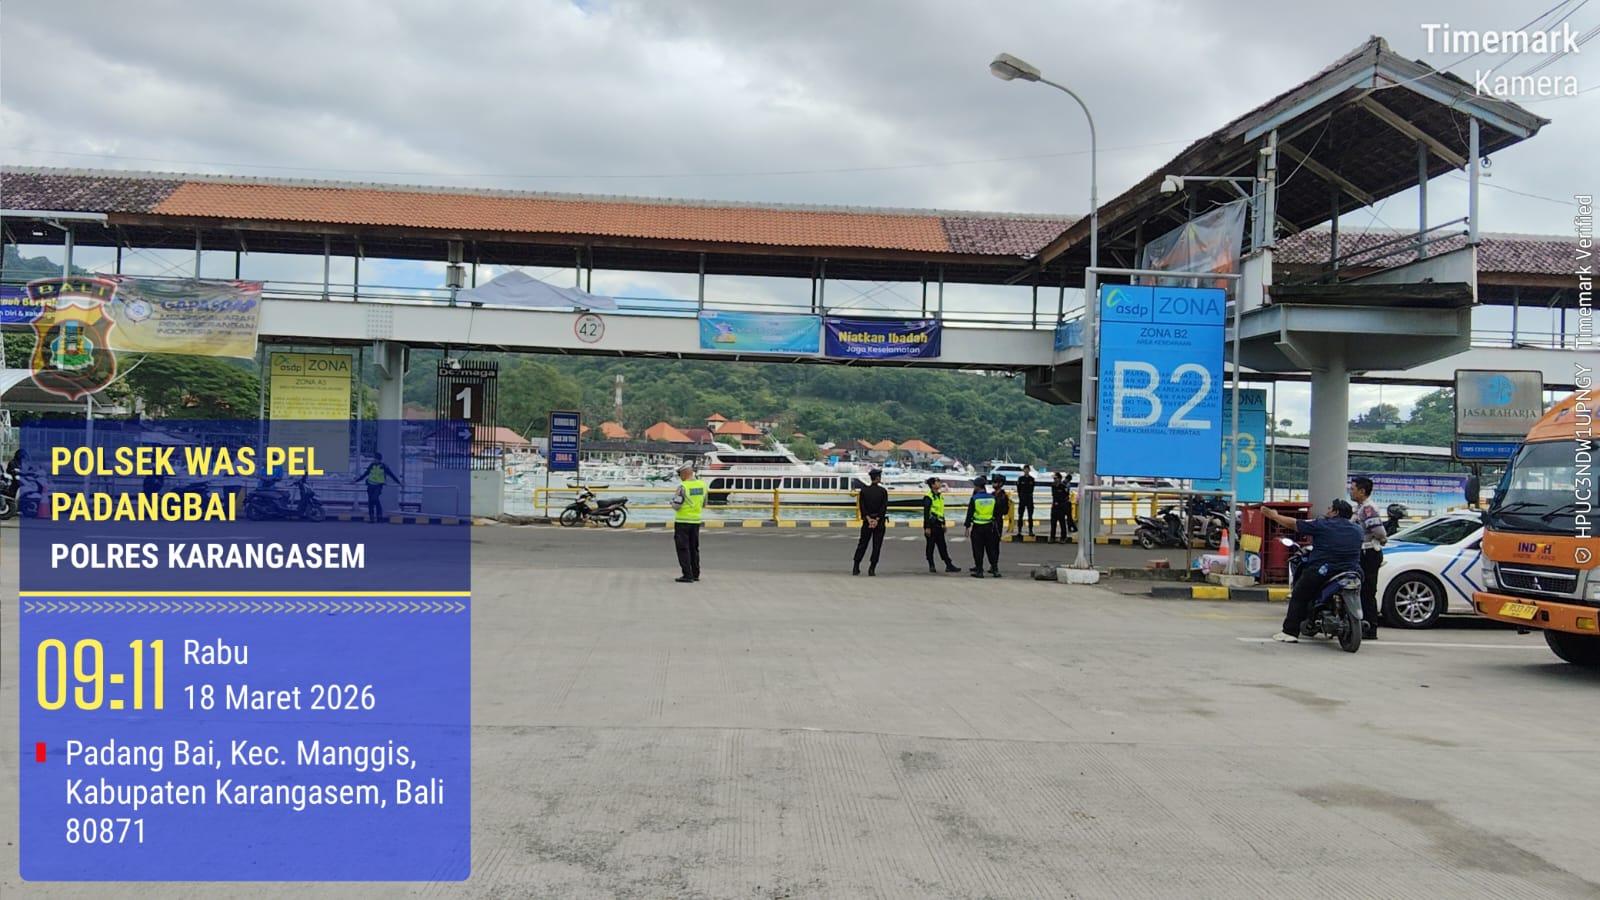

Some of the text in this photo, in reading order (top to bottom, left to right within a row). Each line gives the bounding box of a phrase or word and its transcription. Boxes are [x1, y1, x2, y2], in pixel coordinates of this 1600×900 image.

[1116, 304, 1148, 318] asdp
[1159, 297, 1220, 316] ZONA
[839, 331, 928, 344] Niatkan Ibadah
[1140, 327, 1188, 338] ZONA B2
[846, 346, 867, 355] Jaga
[281, 364, 302, 372] asdp
[308, 360, 349, 371] ZONA
[1113, 360, 1211, 430] B2
[456, 387, 472, 419] 1
[1463, 408, 1537, 420] JASA RAHARJA
